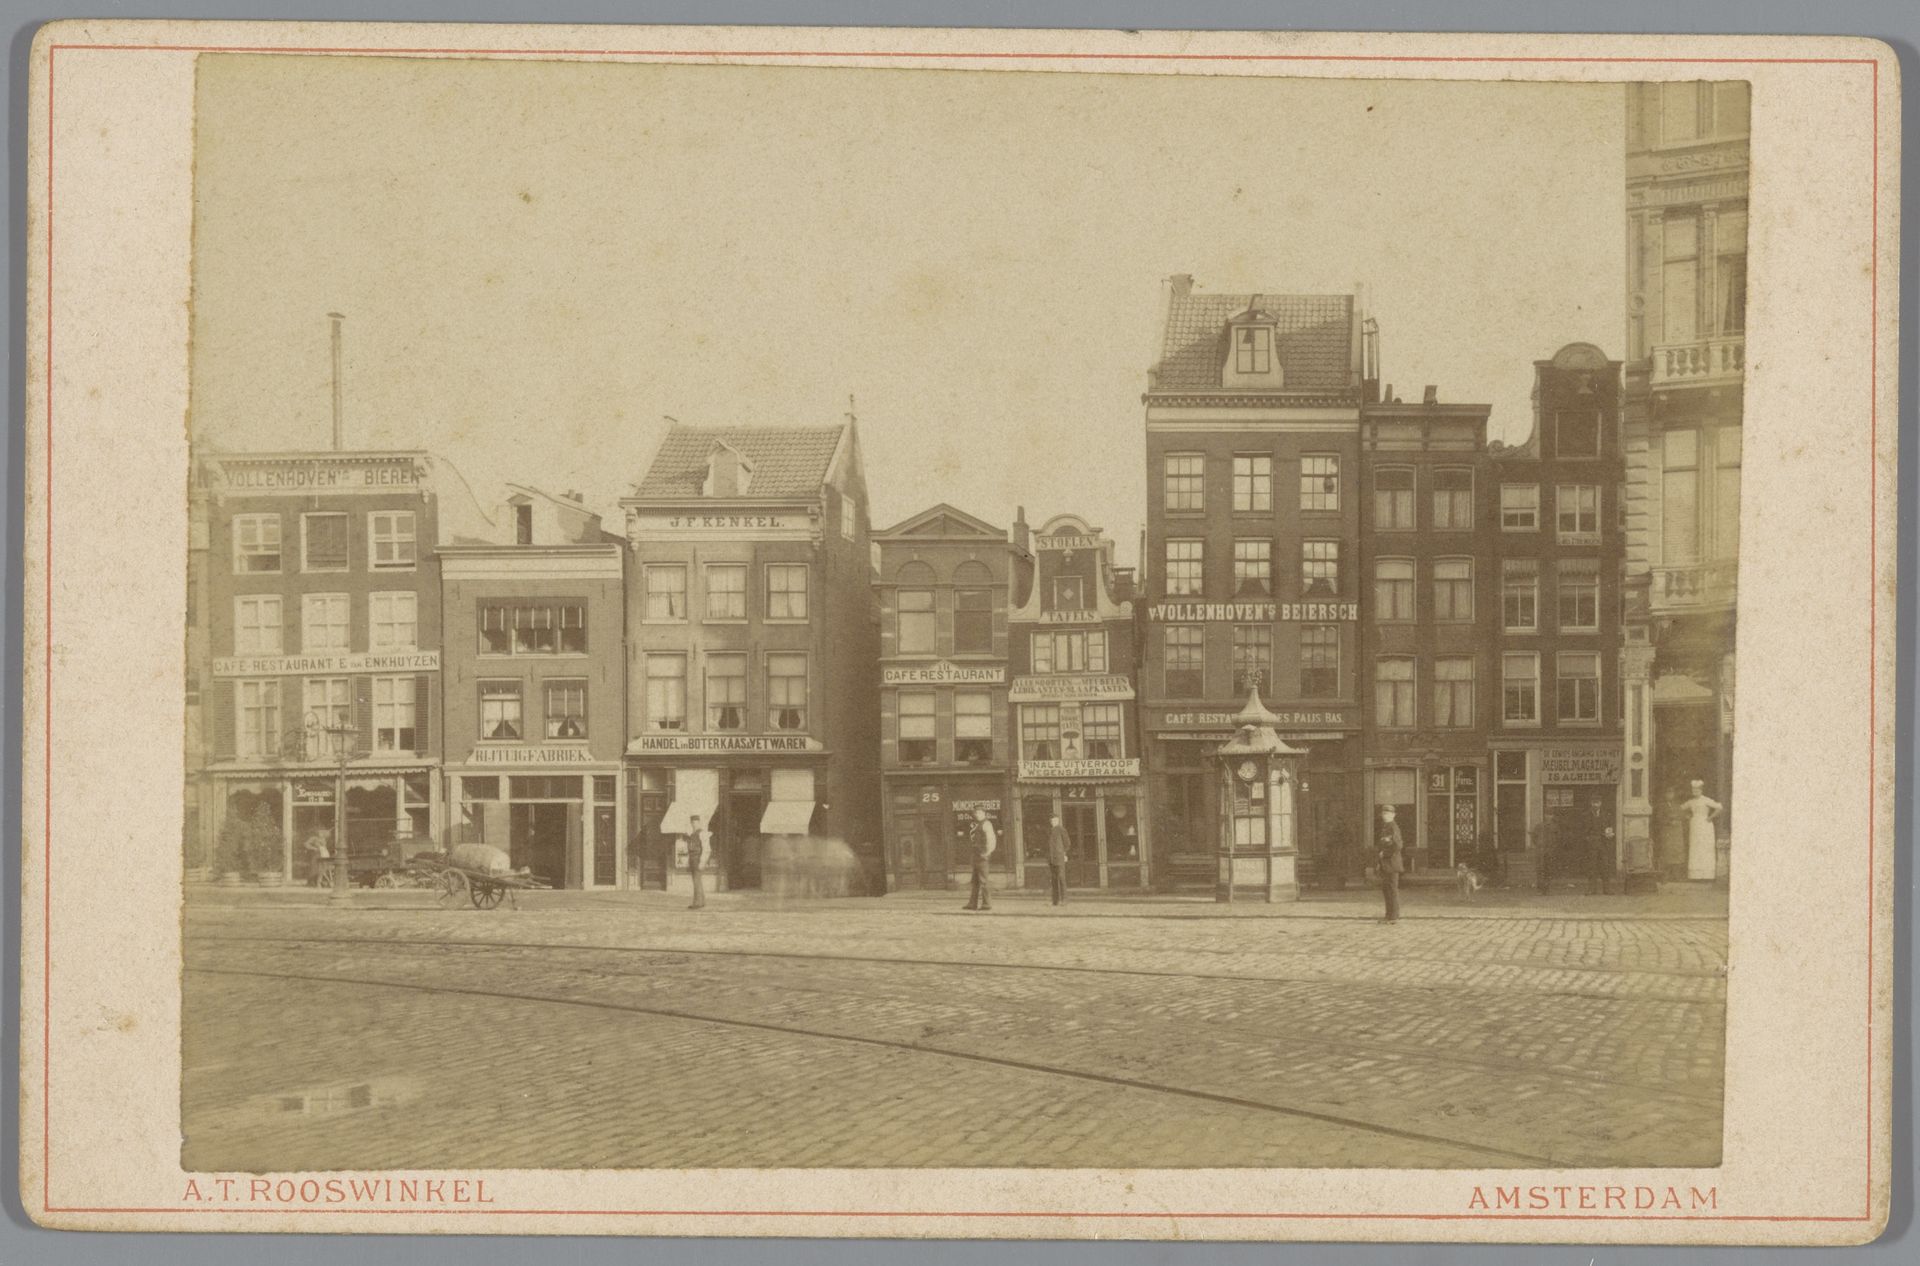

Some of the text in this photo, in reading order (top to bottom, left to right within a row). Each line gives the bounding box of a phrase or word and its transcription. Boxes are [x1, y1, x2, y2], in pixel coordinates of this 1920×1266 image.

[1040, 536, 1094, 549] STOELEN
[1049, 611, 1095, 622] TAFELS
[1281, 603, 1358, 621] BEIERSCH
[364, 655, 438, 669] ENKHUYZEN
[920, 669, 1002, 681] RESTAURANT
[1081, 677, 1128, 686] MEUBELEN
[642, 737, 680, 750] HANDEL
[1063, 760, 1134, 769] UITVERKOOP
[1028, 768, 1071, 776] WEGENS
[1562, 772, 1602, 781] ALHIER
[1432, 774, 1445, 787] 31
[922, 792, 940, 803] 25
[1068, 786, 1087, 798] 27
[249, 1178, 494, 1203] ROOSWINKEL
[1468, 1185, 1718, 1210] AMSTERDAM
